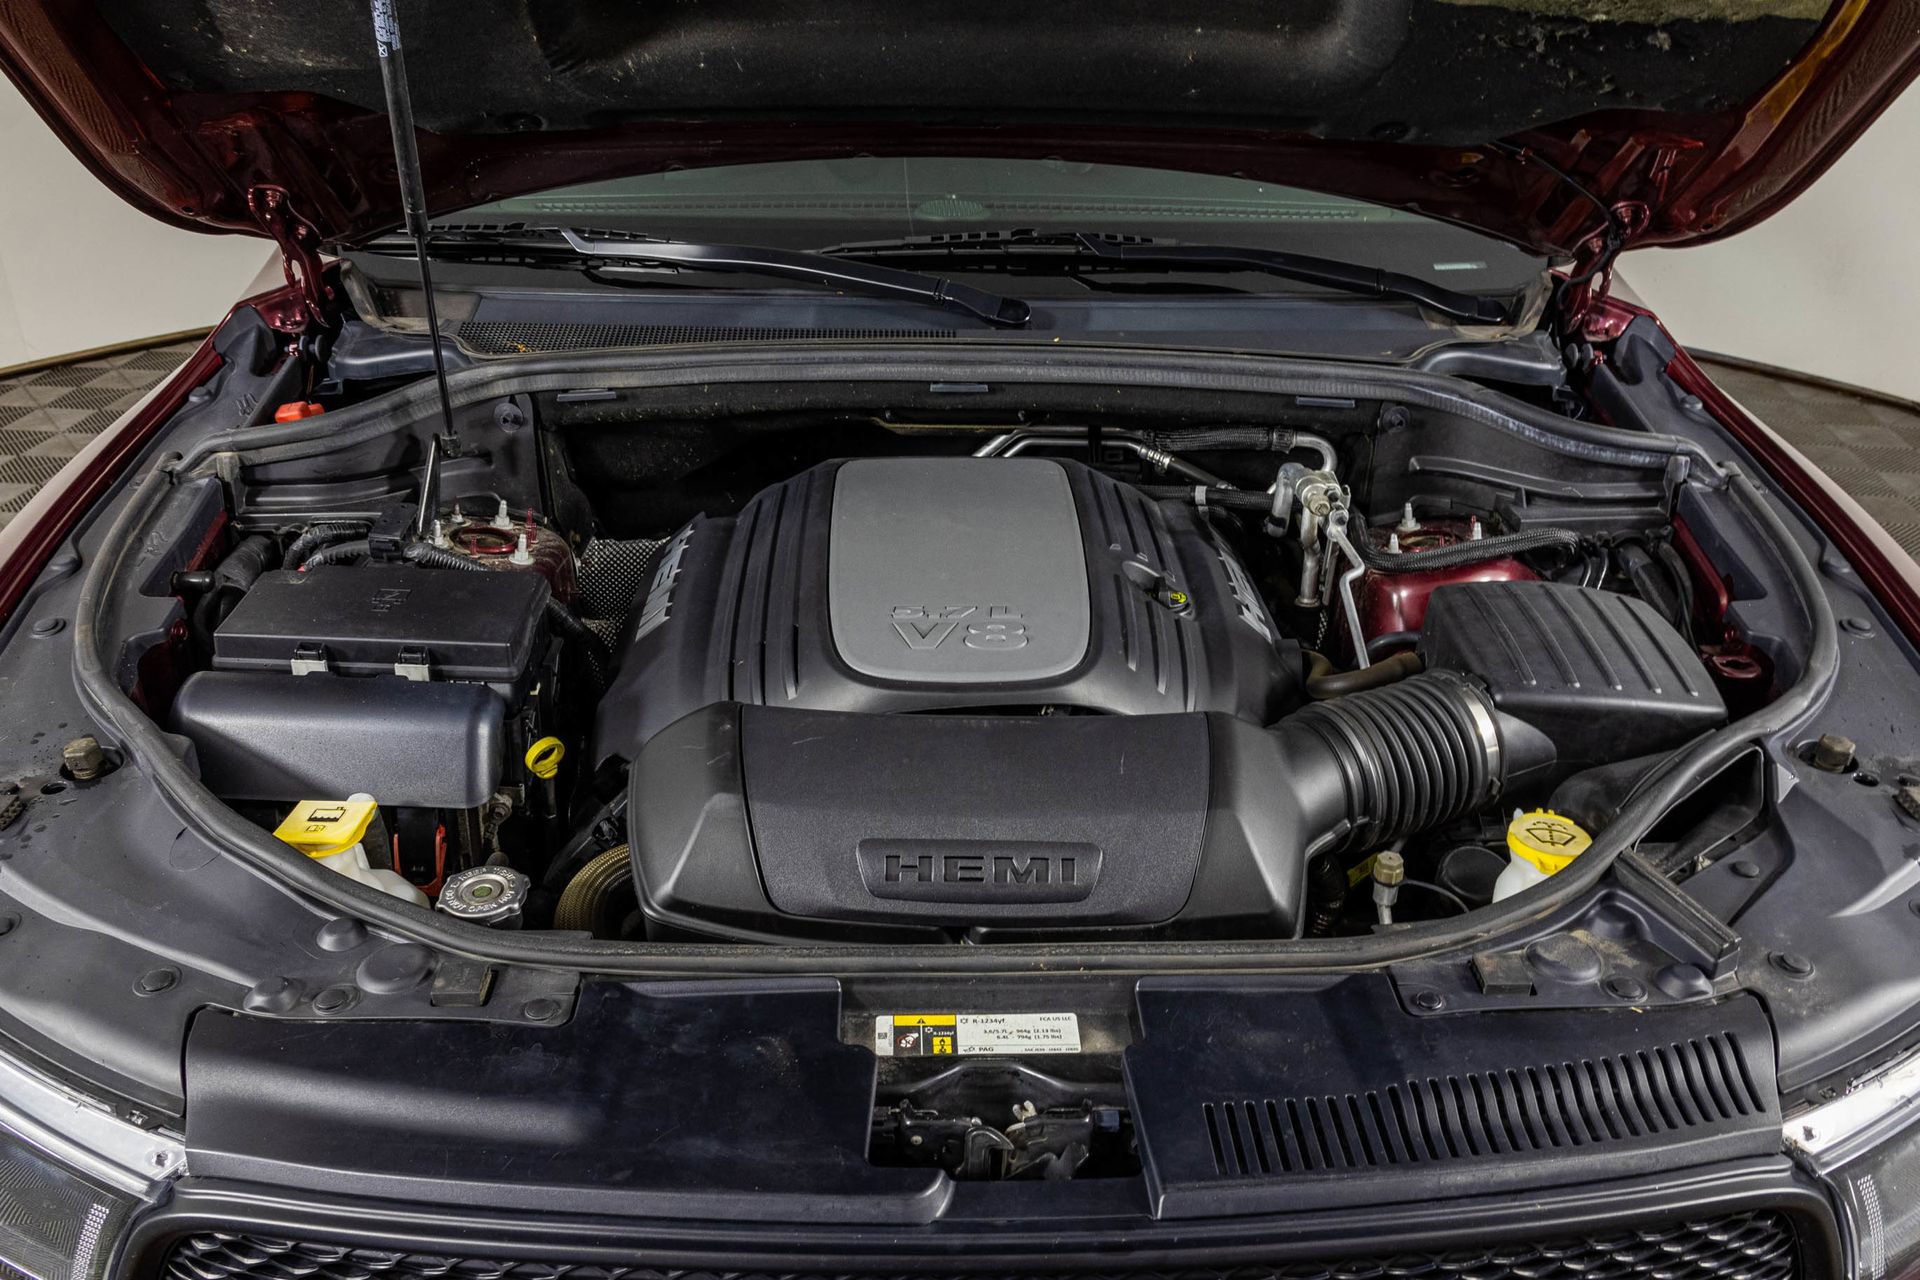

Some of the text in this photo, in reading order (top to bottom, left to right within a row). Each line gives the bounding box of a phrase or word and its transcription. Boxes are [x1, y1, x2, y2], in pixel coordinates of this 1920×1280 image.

[635, 523, 695, 642] HEMI
[891, 621, 1029, 650] V8
[884, 855, 1077, 886] HEMI
[498, 890, 516, 904] HOT
[972, 1017, 1005, 1025] R-1234yf
